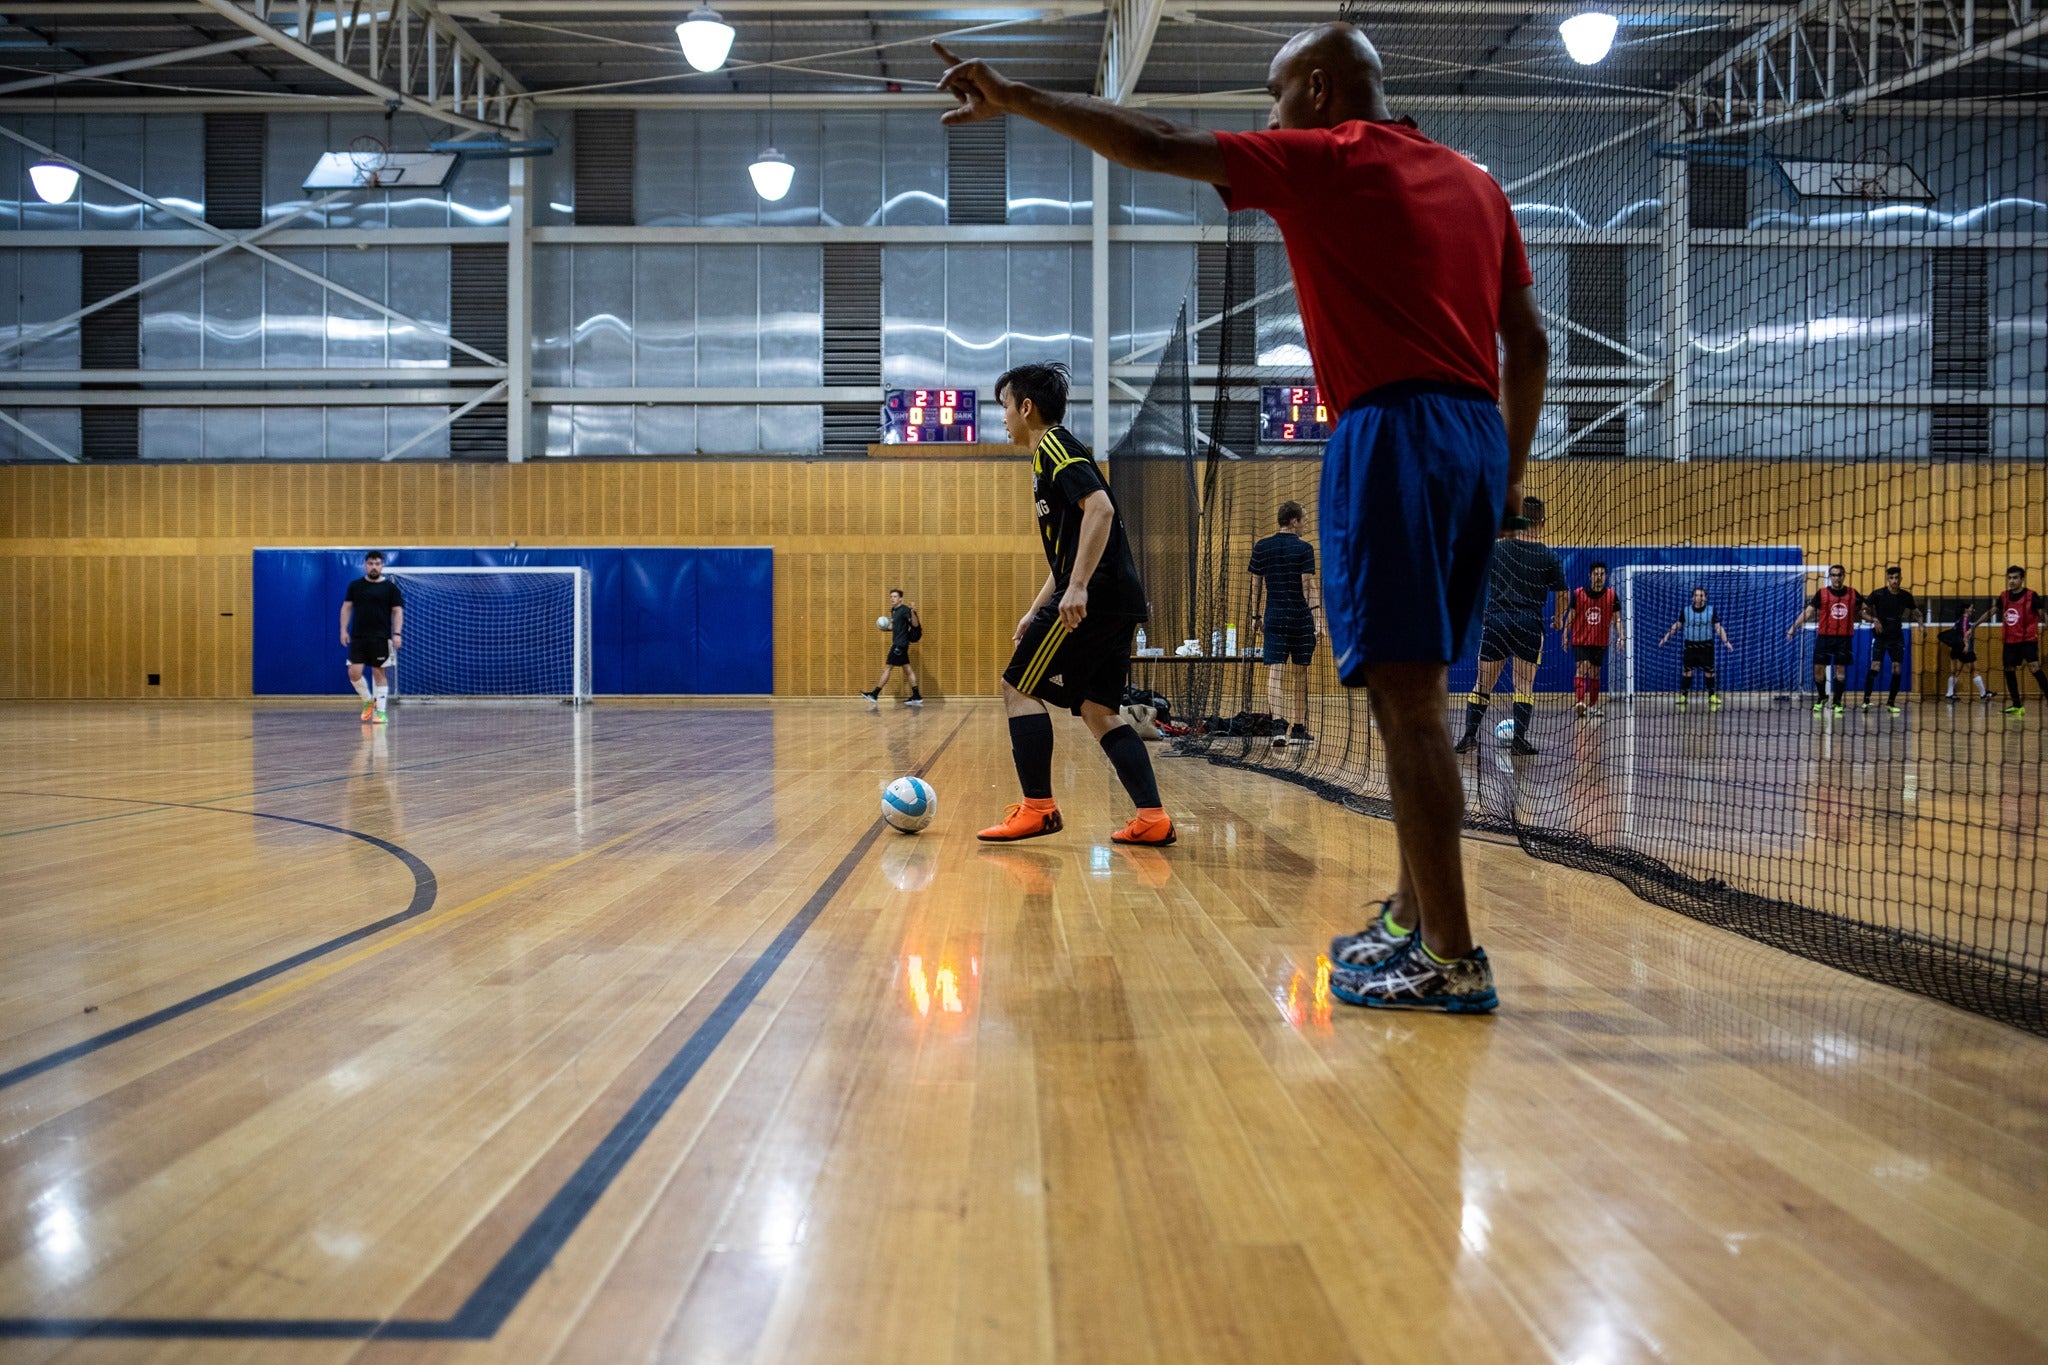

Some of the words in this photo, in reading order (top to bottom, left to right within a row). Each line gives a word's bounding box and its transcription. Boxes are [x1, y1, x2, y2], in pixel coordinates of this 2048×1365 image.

[915, 390, 927, 406] 2
[939, 390, 957, 406] 13
[909, 407, 923, 425] 0
[939, 407, 953, 425] 0
[907, 426, 918, 442] 5
[966, 426, 972, 442] 1
[1284, 424, 1294, 439] 2
